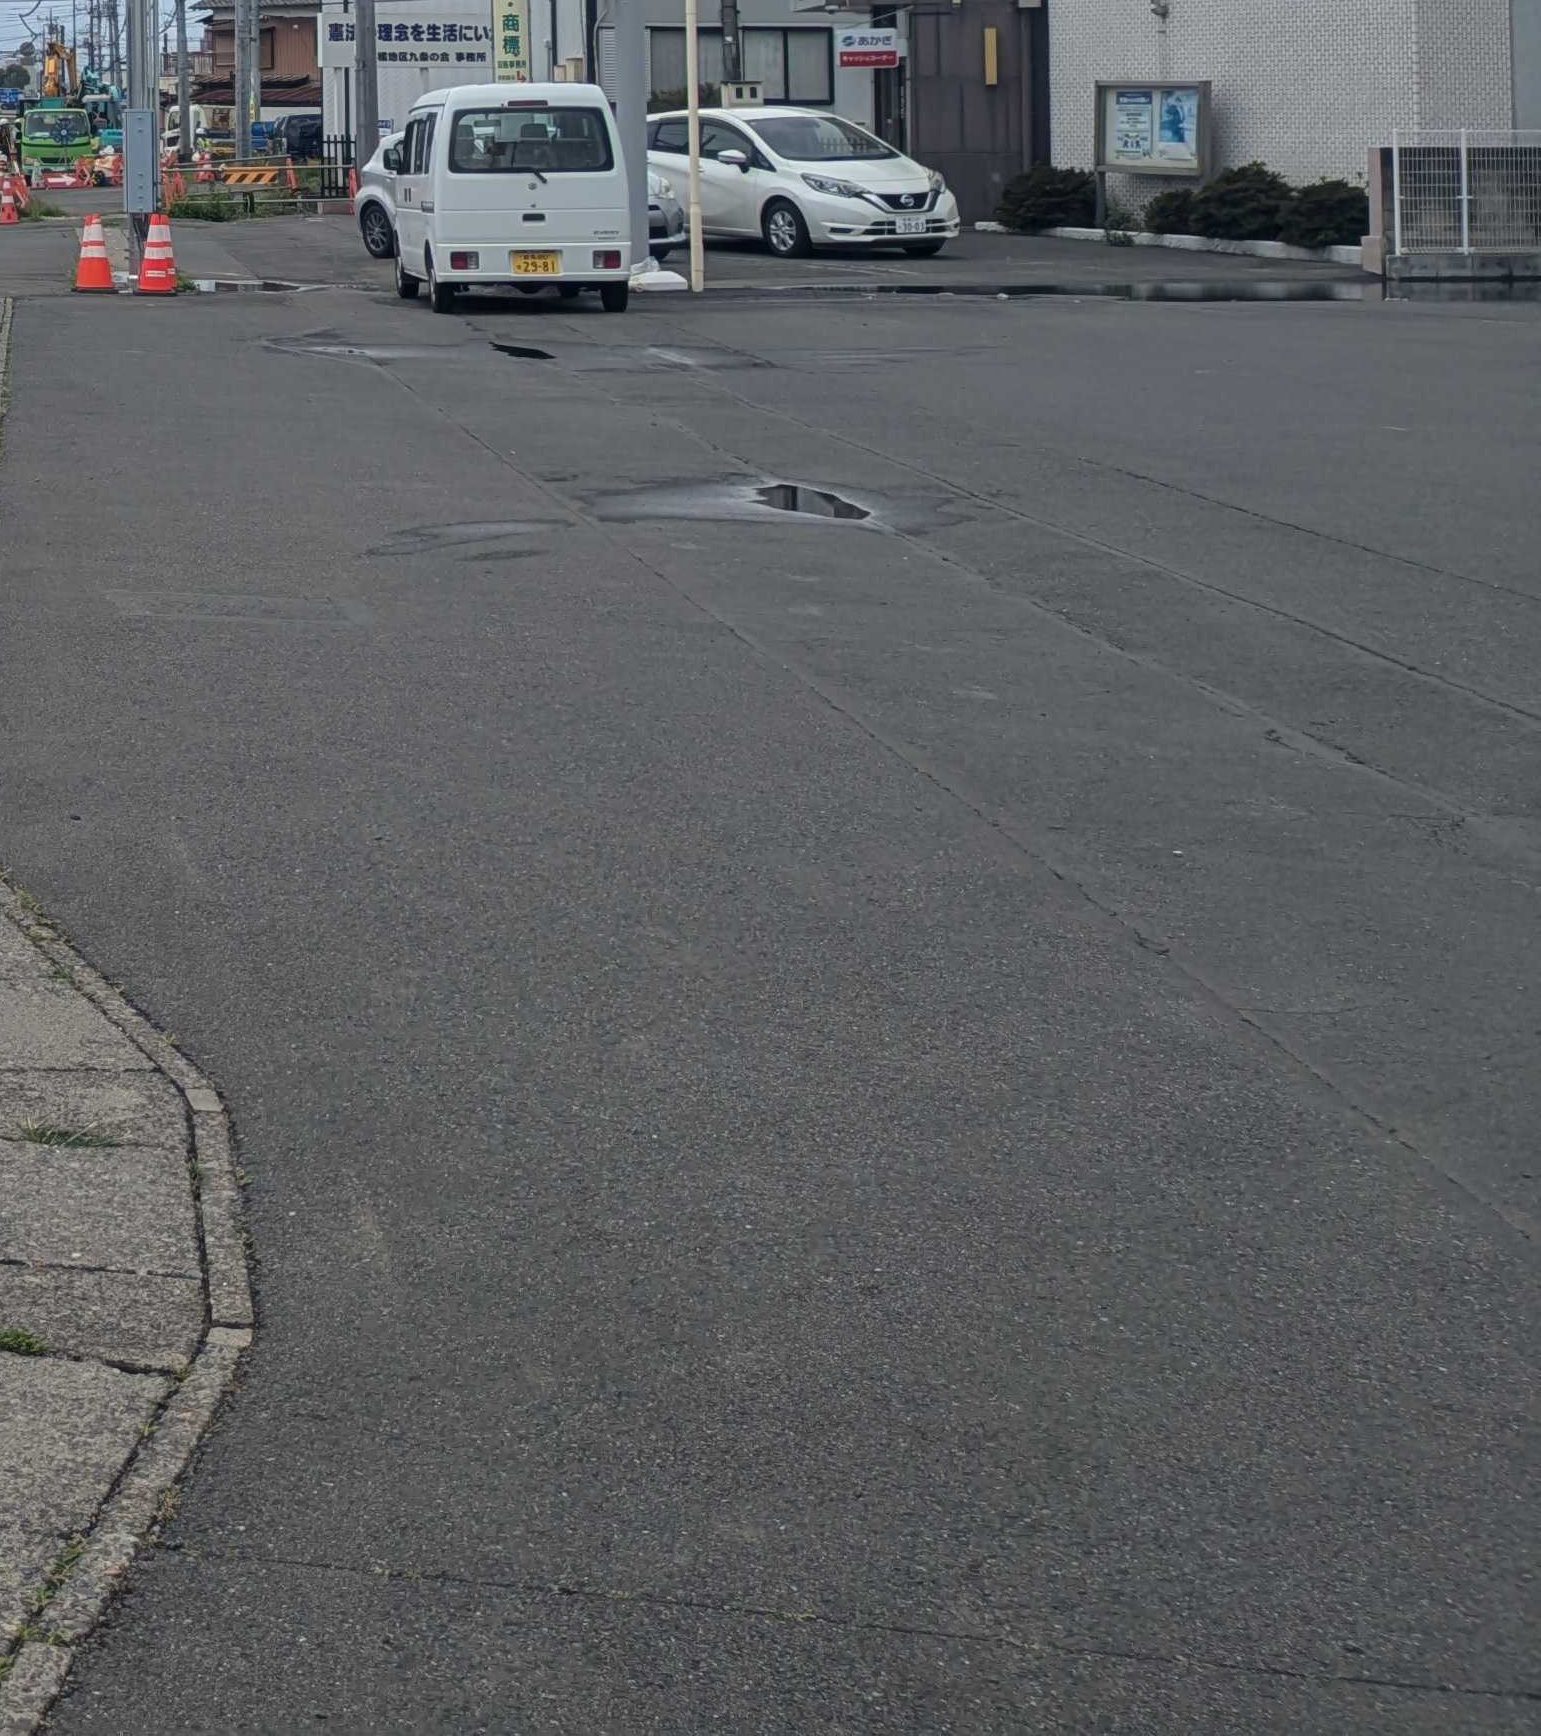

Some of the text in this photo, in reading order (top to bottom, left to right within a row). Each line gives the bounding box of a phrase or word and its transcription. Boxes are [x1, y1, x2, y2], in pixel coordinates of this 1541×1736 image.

[328, 23, 494, 43] 憲法理念を生活にい
[455, 51, 486, 63] 事務所
